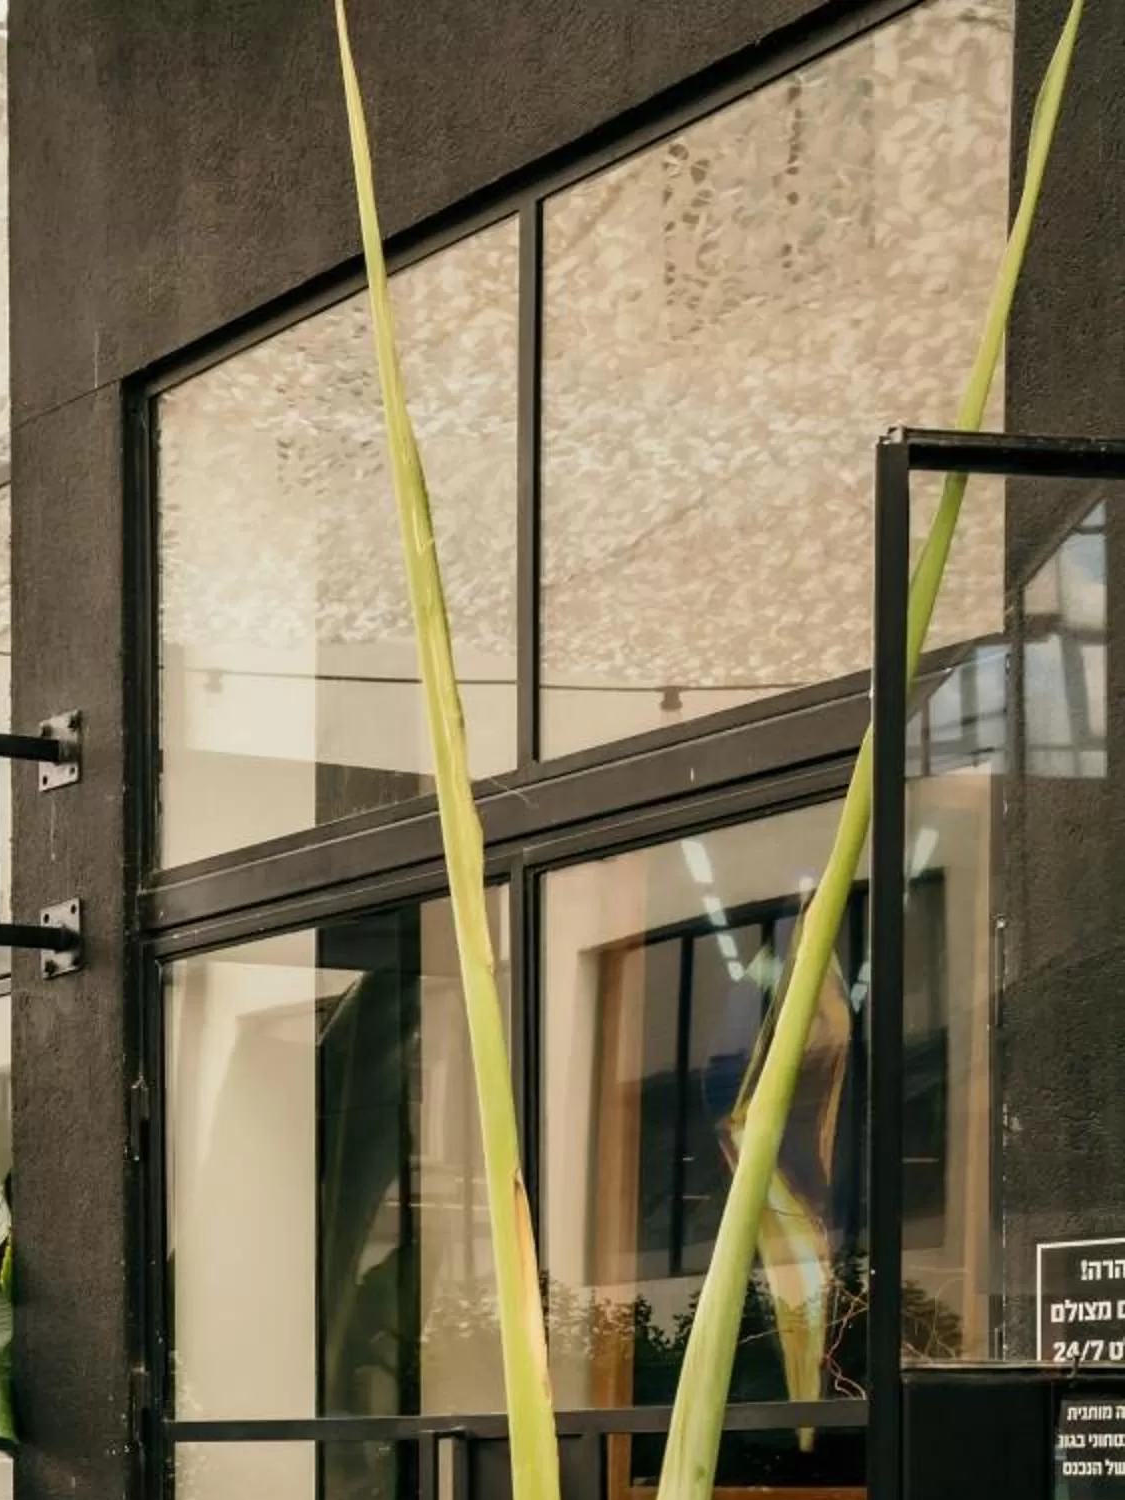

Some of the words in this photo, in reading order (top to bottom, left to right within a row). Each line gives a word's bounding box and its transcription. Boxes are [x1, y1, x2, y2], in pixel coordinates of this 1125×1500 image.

[1050, 1299, 1112, 1322] מצולם
[1053, 1340, 1104, 1362] 24/7
[1067, 1406, 1112, 1420] מותנית
[1062, 1461, 1102, 1475] הנכנס
[1105, 1459, 1125, 1475] של
